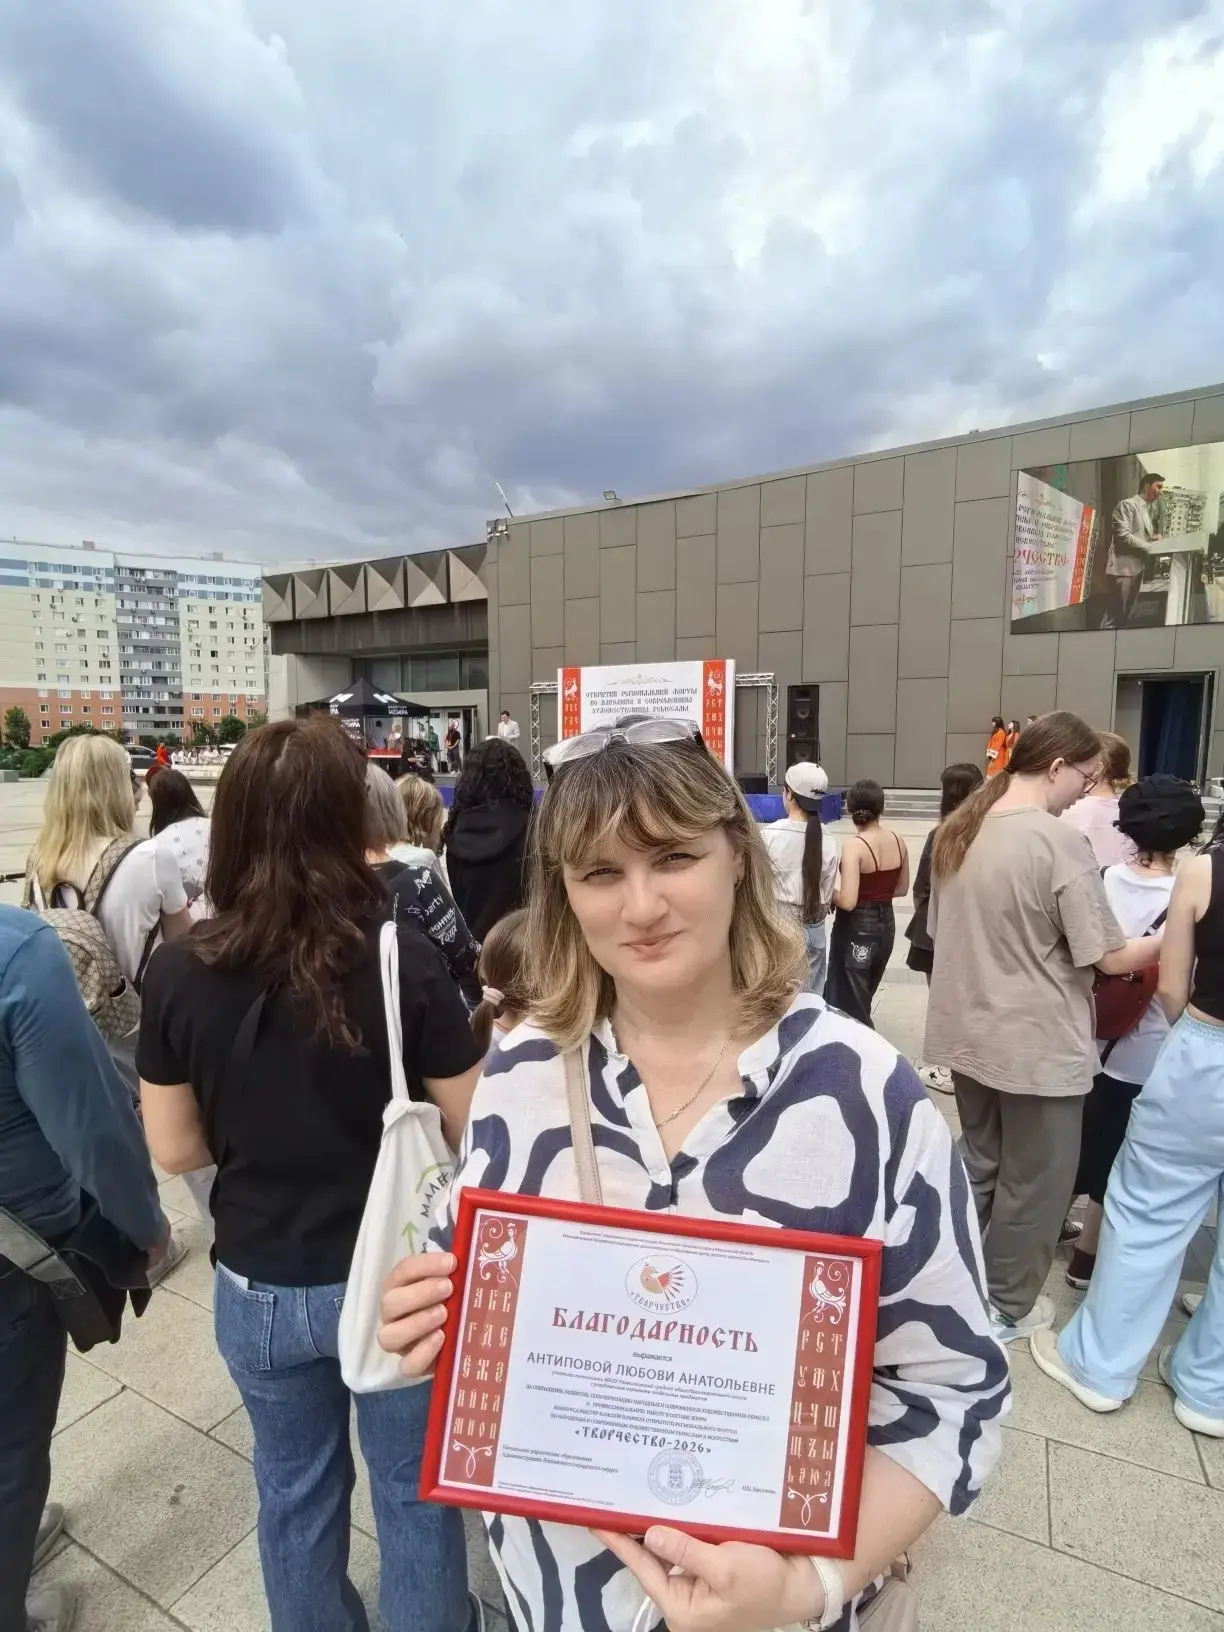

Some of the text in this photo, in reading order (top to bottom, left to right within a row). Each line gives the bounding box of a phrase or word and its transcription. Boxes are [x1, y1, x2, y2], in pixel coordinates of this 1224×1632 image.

[552, 1307, 758, 1352] БЛАГОДАРНОСТЬ
[527, 1352, 775, 1395] АНТИПОВОЙ ЛЮБОВИ АНАТОЛЬЕВНЕ
[632, 1352, 672, 1362] выражается
[575, 1426, 711, 1453] «ТВОРЧЕСТВО-2026»
